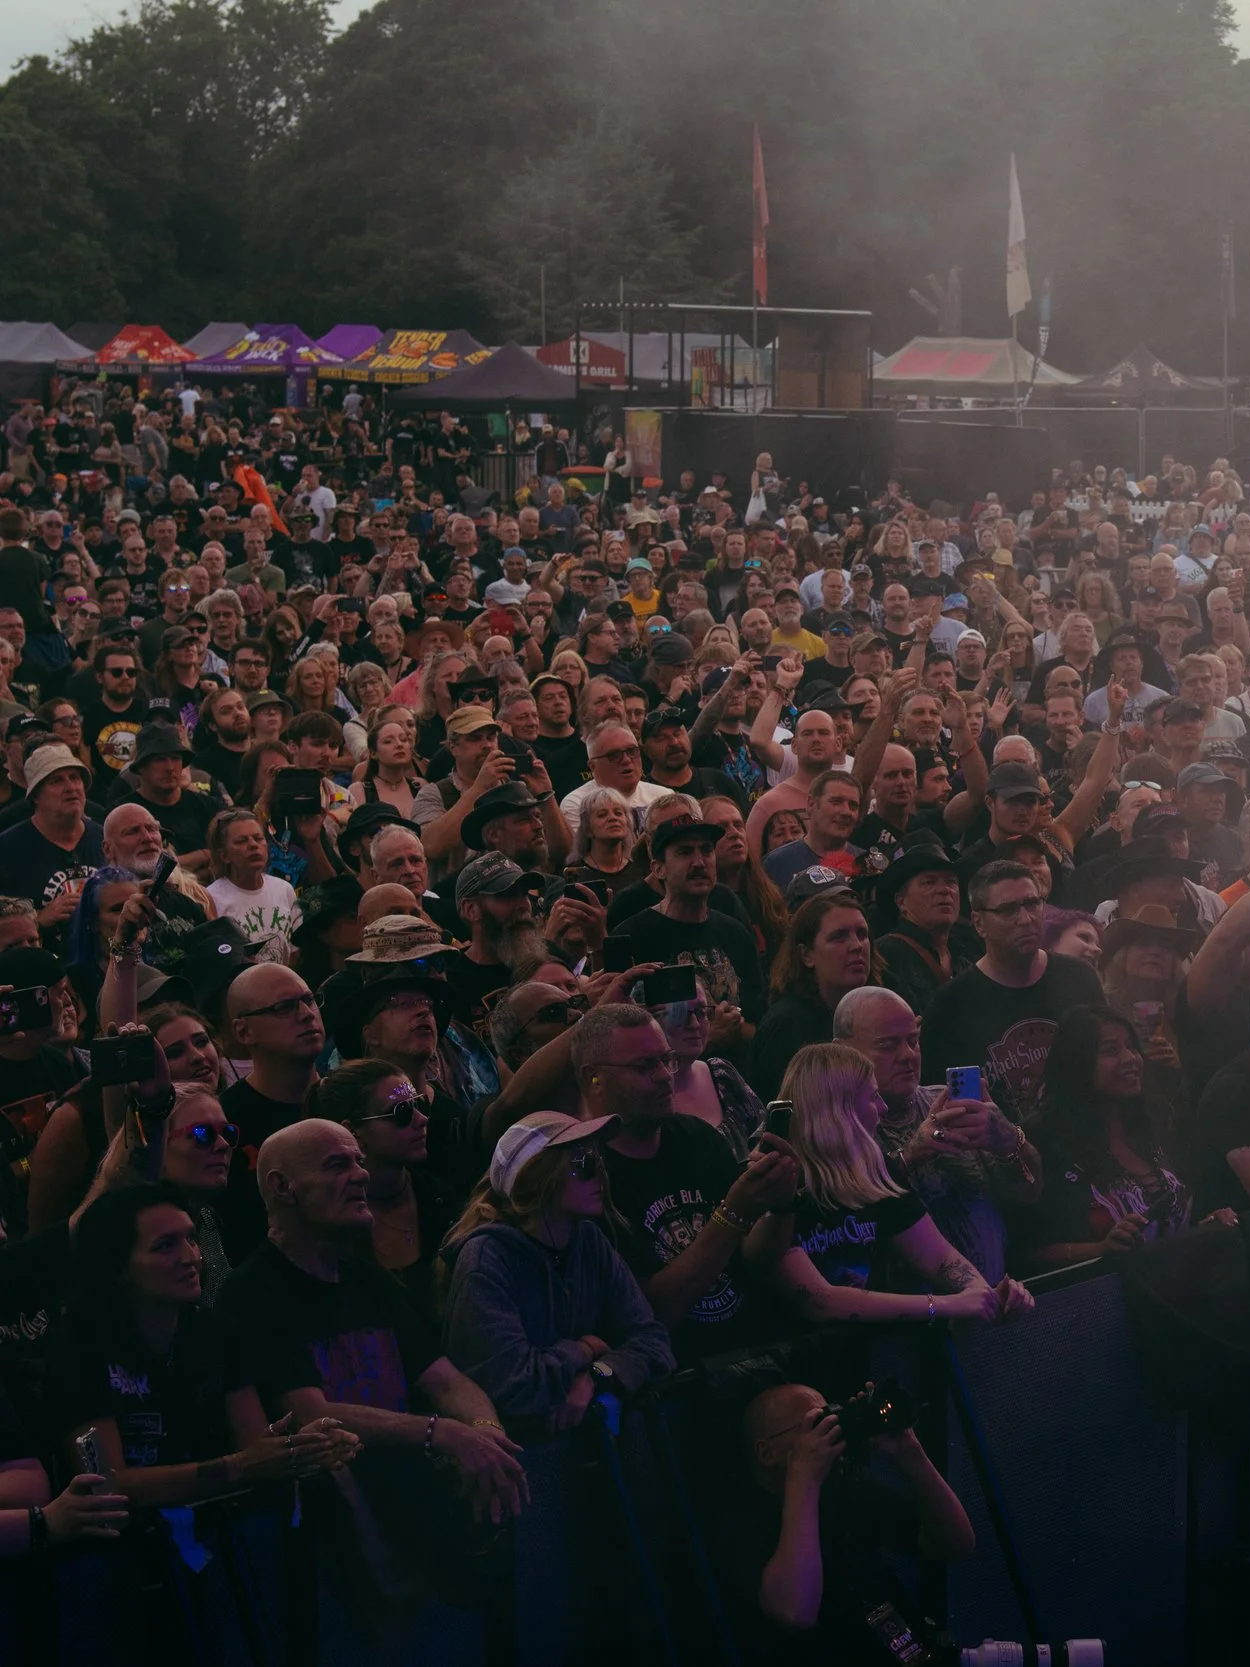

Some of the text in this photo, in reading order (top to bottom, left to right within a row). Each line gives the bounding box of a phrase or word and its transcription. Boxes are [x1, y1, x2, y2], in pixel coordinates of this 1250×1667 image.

[590, 366, 617, 377] GRILL
[981, 1041, 1052, 1092] Black Ston
[889, 1631, 913, 1652] CREW
